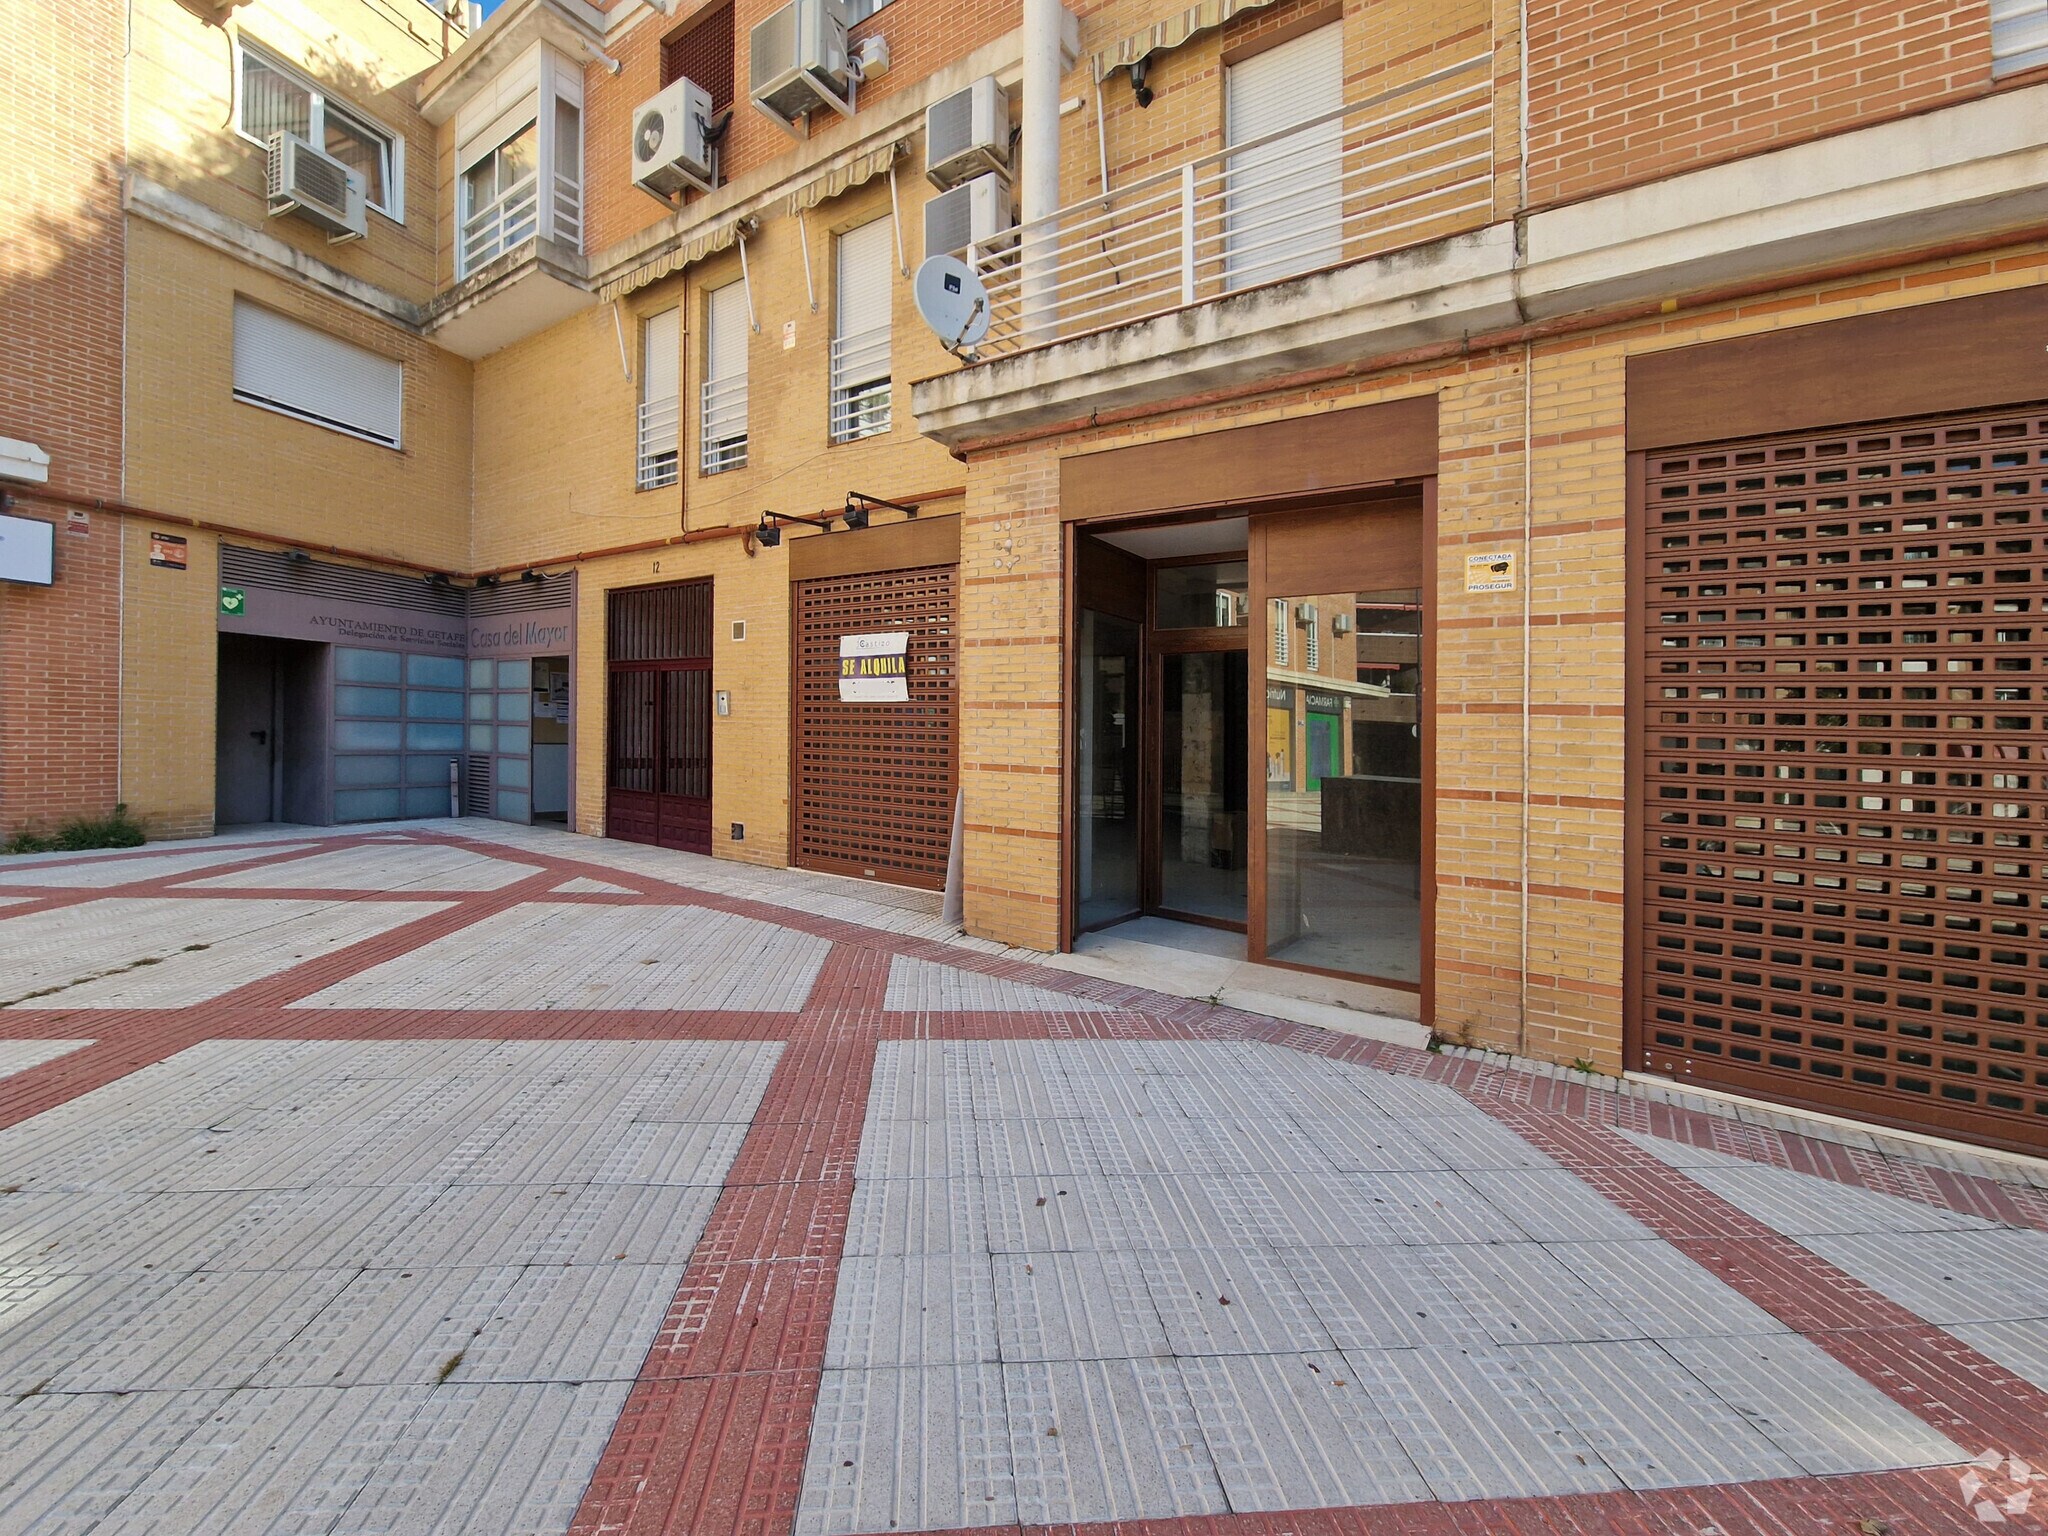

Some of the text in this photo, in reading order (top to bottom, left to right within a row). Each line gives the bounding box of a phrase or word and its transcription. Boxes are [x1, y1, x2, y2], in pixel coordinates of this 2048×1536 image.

[1468, 553, 1512, 562] CONECTADA
[652, 561, 660, 574] 12
[1468, 582, 1513, 591] PROSEGUR
[309, 615, 465, 642] AYUNTAMIENTO DE GETAFE
[339, 628, 385, 640] Delegación
[470, 621, 568, 649] Casa del Mayor
[842, 656, 906, 676] SE ALQUILA
